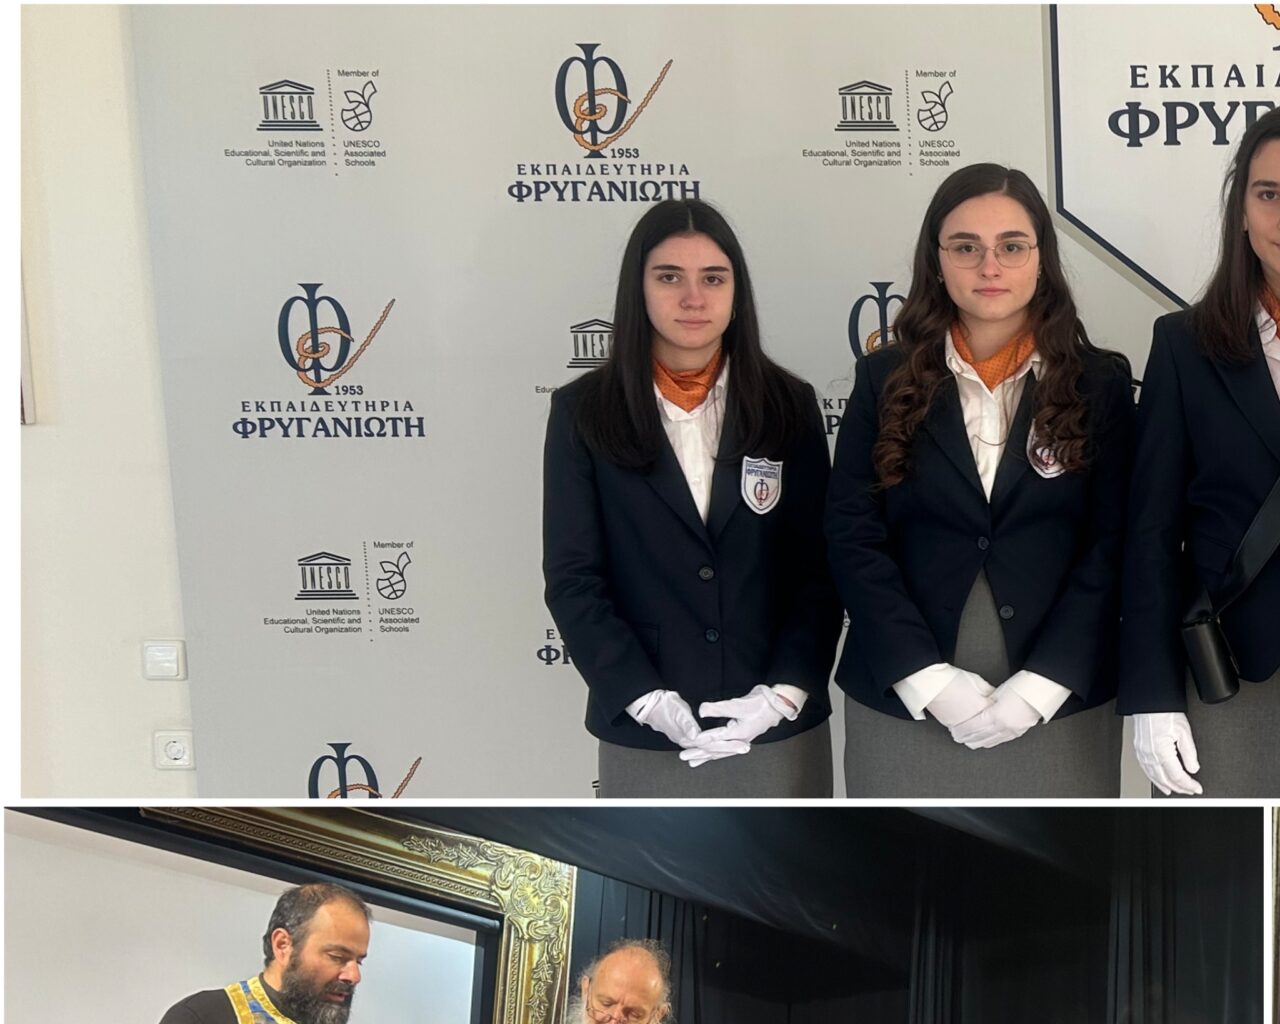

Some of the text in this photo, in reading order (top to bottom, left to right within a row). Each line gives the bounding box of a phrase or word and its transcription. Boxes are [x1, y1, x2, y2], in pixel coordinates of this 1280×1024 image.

[263, 95, 314, 120] UNESCO
[842, 96, 891, 120] UNESCO
[268, 140, 325, 148] United Nations
[343, 140, 380, 148] UNESCO
[845, 140, 901, 148] United Nations
[919, 140, 955, 148] UNESCO
[224, 150, 272, 158] Educational,
[611, 148, 640, 158] 1953
[803, 150, 847, 158] Educational,
[277, 159, 327, 168] Organization
[854, 159, 901, 168] Organization
[517, 164, 690, 175] ΕΚΠΑΙΔΕΥΤΗΡΙΑ
[335, 385, 363, 395] 1953
[241, 401, 414, 412] ΕΚΠΑΙΔΕΥΤΗΡΙΑ
[232, 416, 426, 438] ΦΡΥΓΑΝΙΩΤΗ
[301, 566, 350, 590] UNESCO
[312, 617, 345, 625] Scientific
[347, 617, 361, 625] and
[315, 626, 362, 635] Organization
